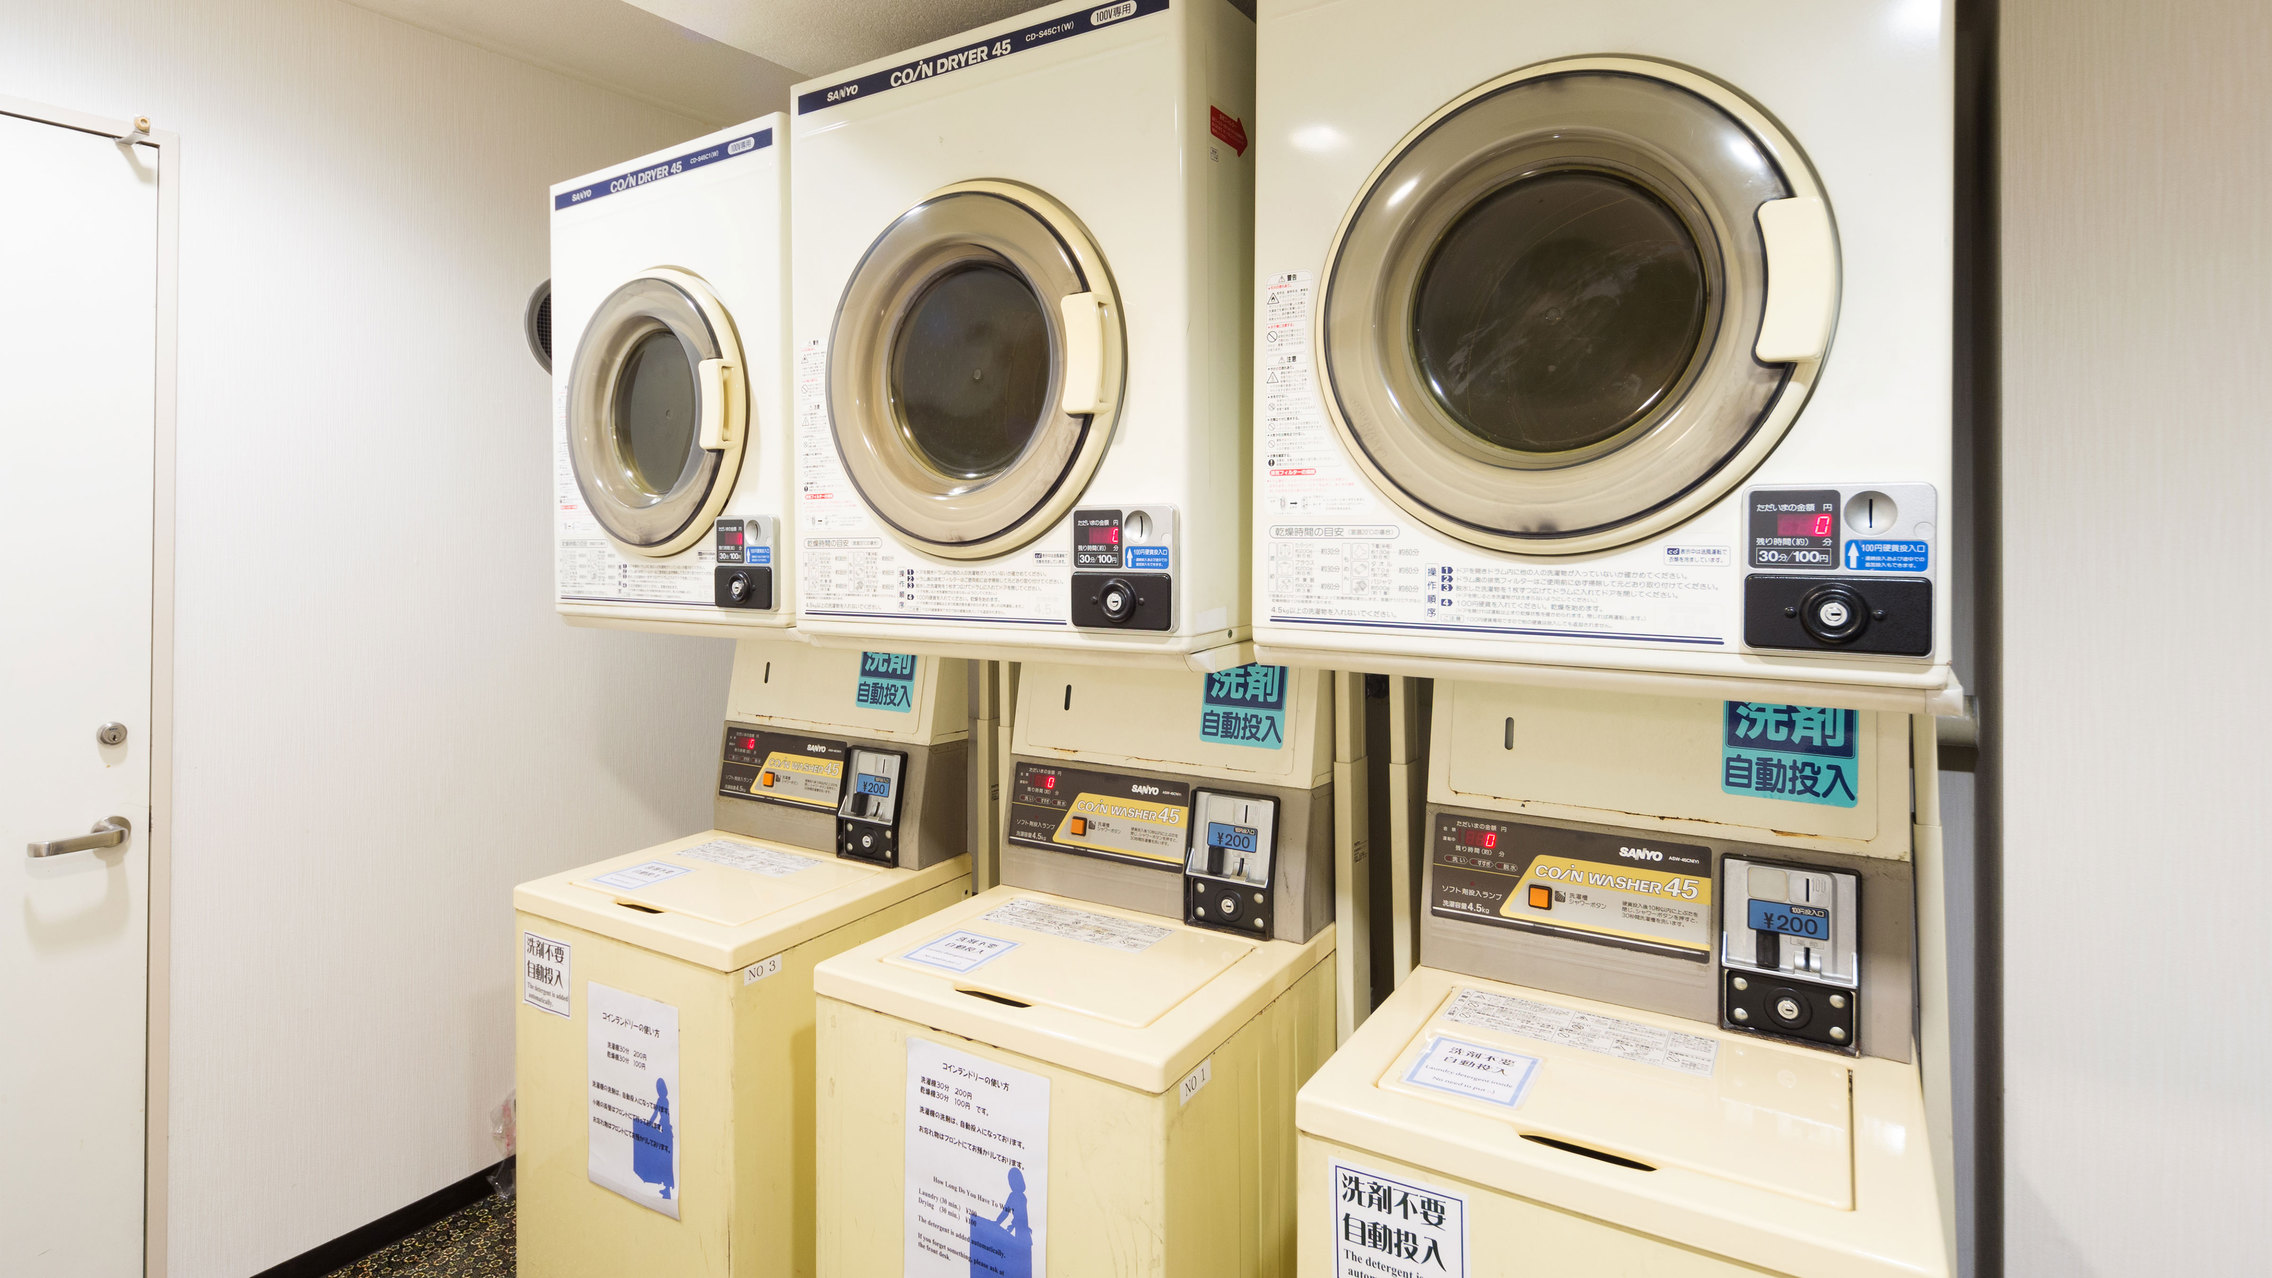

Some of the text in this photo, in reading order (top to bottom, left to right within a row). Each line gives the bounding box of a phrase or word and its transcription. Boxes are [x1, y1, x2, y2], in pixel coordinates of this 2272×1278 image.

[827, 85, 858, 102] SANYO
[936, 47, 989, 74] DRYER
[992, 39, 1012, 56] 45
[572, 189, 592, 202] SANYO
[638, 165, 669, 186] DRYER
[670, 160, 682, 175] 45
[1757, 503, 1832, 512] ただいまの金額 円
[1814, 515, 1830, 535] 0
[1822, 538, 1832, 546] 分
[1758, 550, 1829, 563] 30分/100円
[865, 651, 912, 675] 洗剤
[857, 681, 911, 708] 自動投入
[1210, 664, 1280, 703] 洗剤
[1202, 709, 1281, 744] 自動投入
[1735, 702, 1845, 747] 洗剤
[806, 744, 827, 753] SANYO
[824, 762, 840, 776] 45
[1725, 754, 1855, 801] 自動投入
[863, 781, 886, 795] ¥200
[1047, 776, 1055, 788] 0
[1131, 784, 1159, 796] SANYO
[1111, 806, 1157, 821] WASHER
[1158, 807, 1181, 825] 45
[1217, 832, 1250, 849] ¥200
[1485, 833, 1496, 847] 0
[1619, 847, 1663, 862] SANYO
[1588, 871, 1662, 895] WASHER
[1663, 877, 1700, 900] 45
[1764, 911, 1818, 935] ¥200
[526, 936, 565, 965] 洗剤不要
[526, 959, 564, 990] 自動投入
[749, 960, 776, 980] NO 3
[1443, 1056, 1509, 1077] 自動投入
[1448, 1046, 1517, 1067] 洗剤不要
[920, 1075, 973, 1100] 洗濯機30分 200円
[942, 1062, 1010, 1092] コインランドリーの使い方
[1185, 1067, 1205, 1097] NO 1
[920, 1086, 949, 1103] 乾燥機30分
[954, 1097, 971, 1110] 100円
[918, 1188, 939, 1203] Laundry
[918, 1197, 935, 1210] Drying
[933, 1176, 944, 1186] How
[945, 1181, 958, 1192] Long
[958, 1186, 966, 1194] Do
[966, 1189, 977, 1199] You
[977, 1195, 990, 1205] Have
[991, 1199, 999, 1208] To
[1342, 1172, 1446, 1231] 洗剤不要
[918, 1215, 927, 1224] The
[927, 1220, 950, 1234] detergent
[955, 1232, 970, 1243] added
[923, 1235, 932, 1244] you
[932, 1239, 947, 1250] forget
[989, 1264, 998, 1273] ask
[926, 1245, 939, 1256] front
[1342, 1212, 1447, 1272] 自動投入
[1344, 1248, 1413, 1278] The detergent
